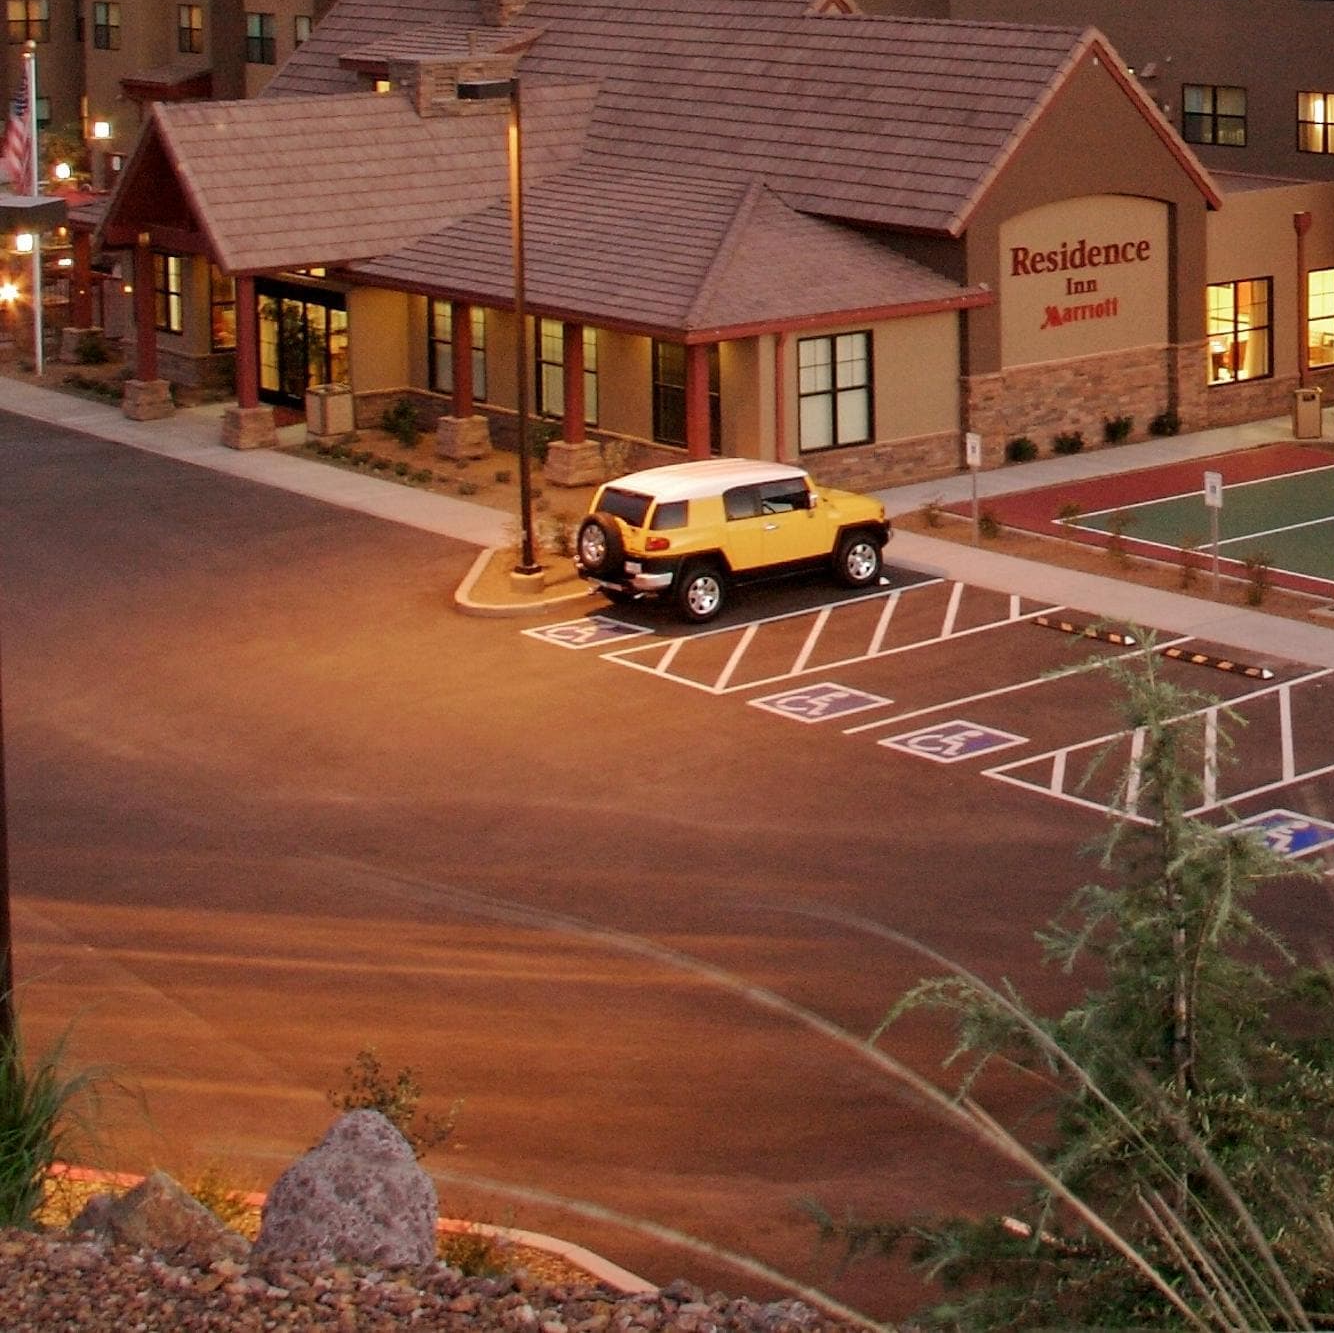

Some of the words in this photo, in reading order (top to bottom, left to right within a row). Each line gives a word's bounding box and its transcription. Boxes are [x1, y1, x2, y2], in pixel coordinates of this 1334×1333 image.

[1009, 238, 1150, 277] Residence
[1066, 277, 1098, 296] Inn
[1040, 297, 1118, 330] Marriott
